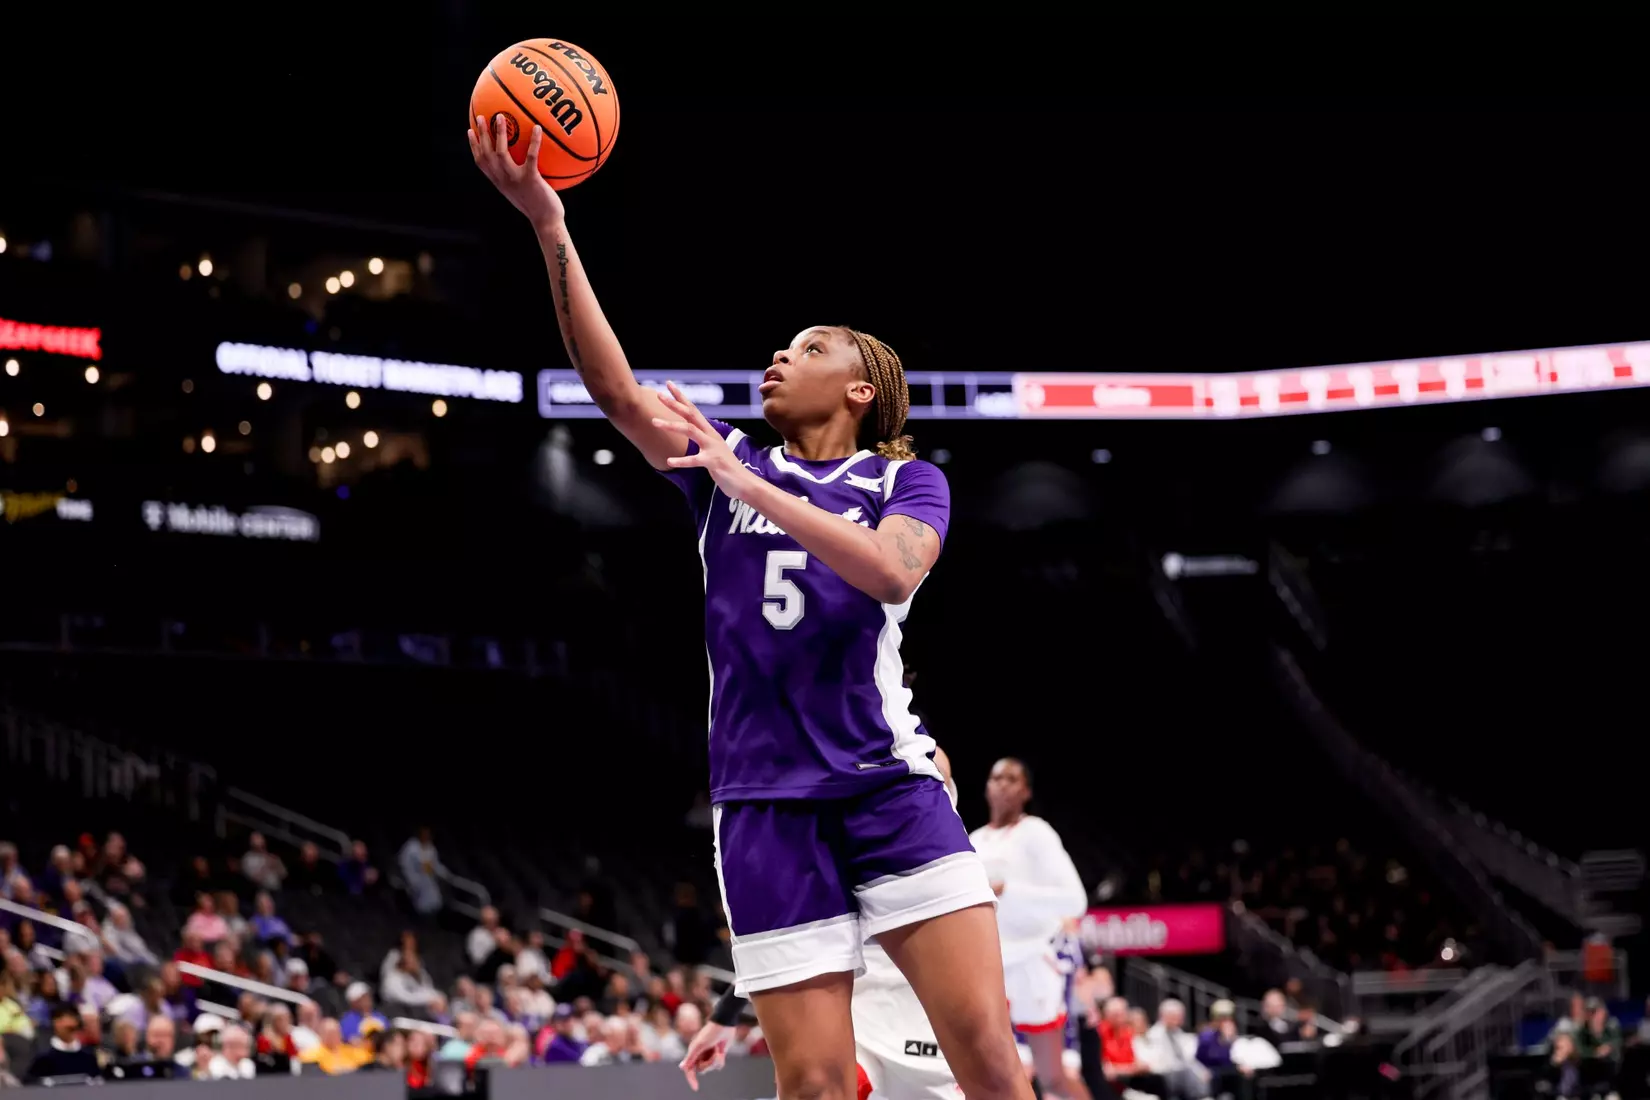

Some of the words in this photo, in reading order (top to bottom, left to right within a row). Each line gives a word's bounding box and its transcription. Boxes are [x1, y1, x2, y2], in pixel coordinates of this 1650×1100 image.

[510, 52, 583, 136] Wilson
[548, 42, 607, 95] NCAA
[762, 550, 807, 630] 5
